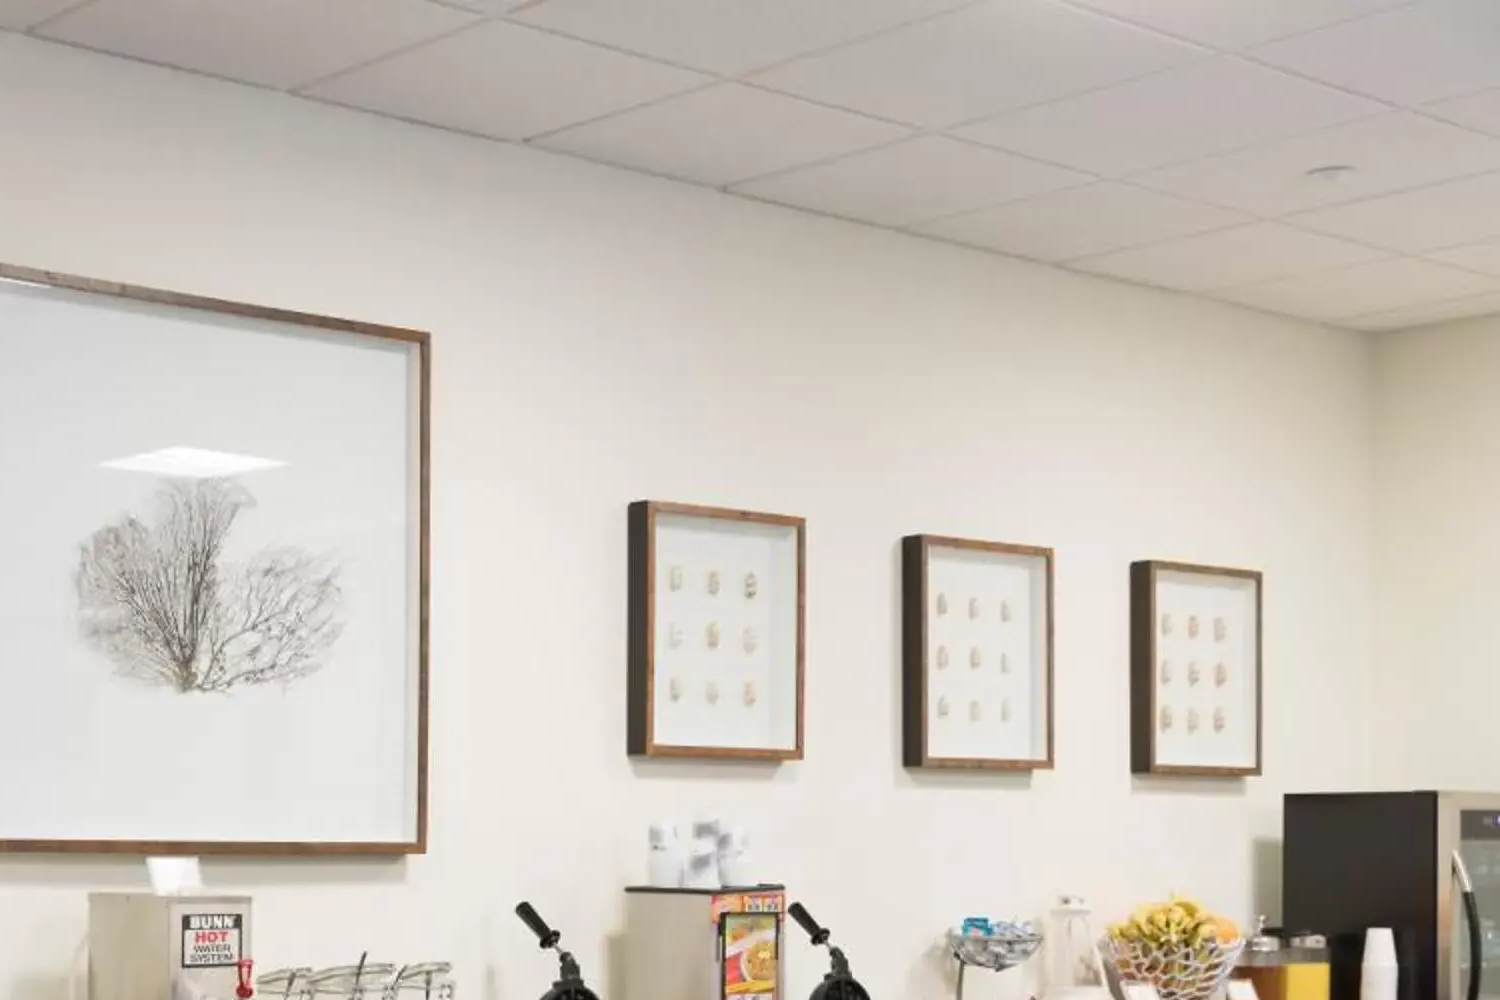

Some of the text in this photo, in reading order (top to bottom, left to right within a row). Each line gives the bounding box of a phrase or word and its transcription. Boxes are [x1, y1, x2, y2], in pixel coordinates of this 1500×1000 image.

[189, 915, 236, 929] BUNN
[195, 931, 228, 943] HOT
[193, 943, 231, 953] WATER
[189, 953, 233, 963] SYSTEM
